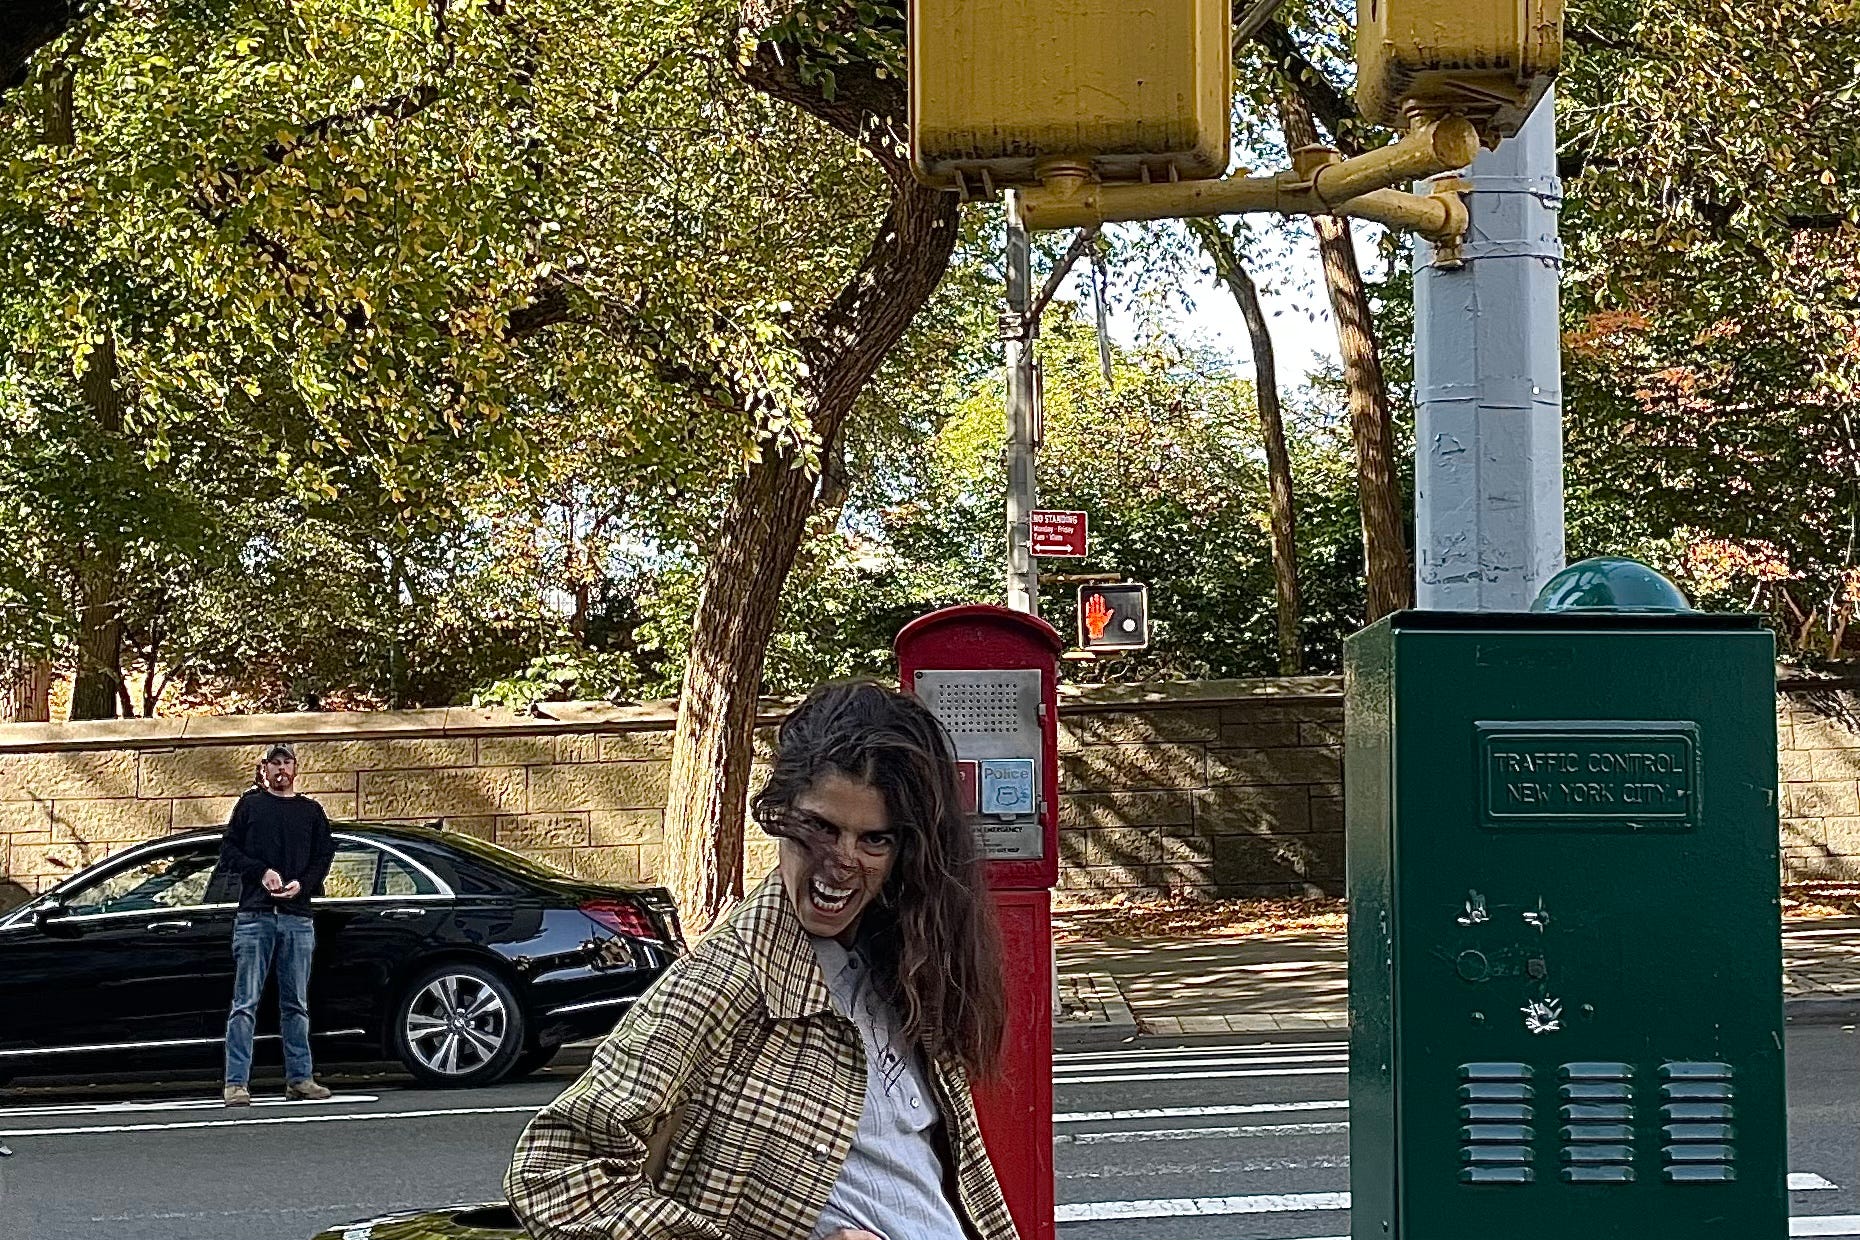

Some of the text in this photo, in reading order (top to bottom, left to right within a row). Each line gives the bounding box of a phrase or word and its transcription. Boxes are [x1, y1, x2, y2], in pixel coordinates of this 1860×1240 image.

[1033, 514, 1078, 525] NO STANDING
[1058, 526, 1074, 534] Friday
[1493, 753, 1683, 772] TRAFFIC CONTROL
[984, 767, 1029, 780] Police
[1507, 783, 1671, 802] NEW YORK CITY
